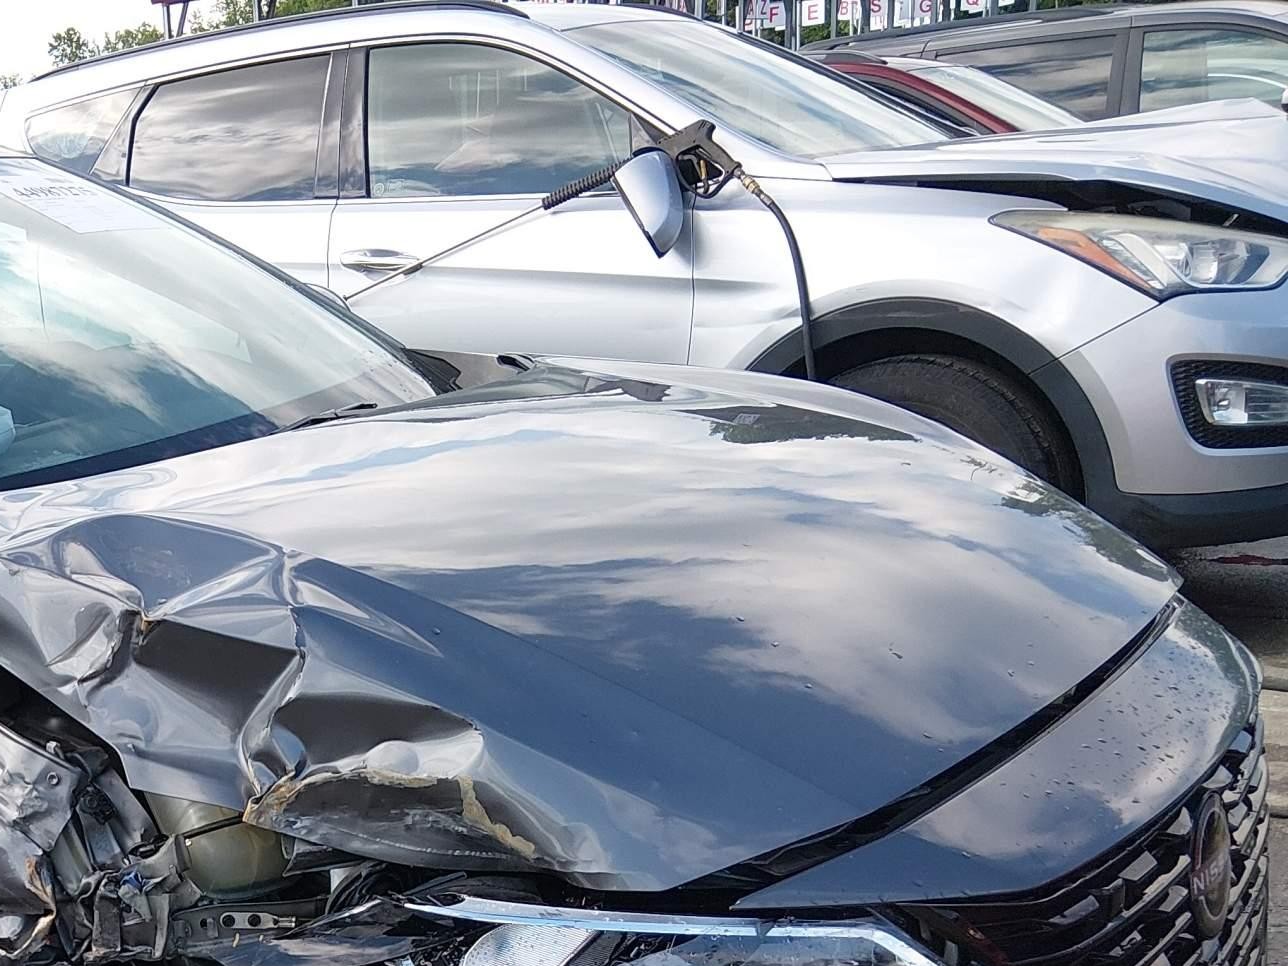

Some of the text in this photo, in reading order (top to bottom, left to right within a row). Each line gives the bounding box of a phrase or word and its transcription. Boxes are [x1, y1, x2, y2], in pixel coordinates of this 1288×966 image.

[769, 5, 780, 24] F
[807, 3, 819, 21] E
[839, 0, 849, 16] B
[871, 0, 882, 13] S
[919, 0, 932, 13] G
